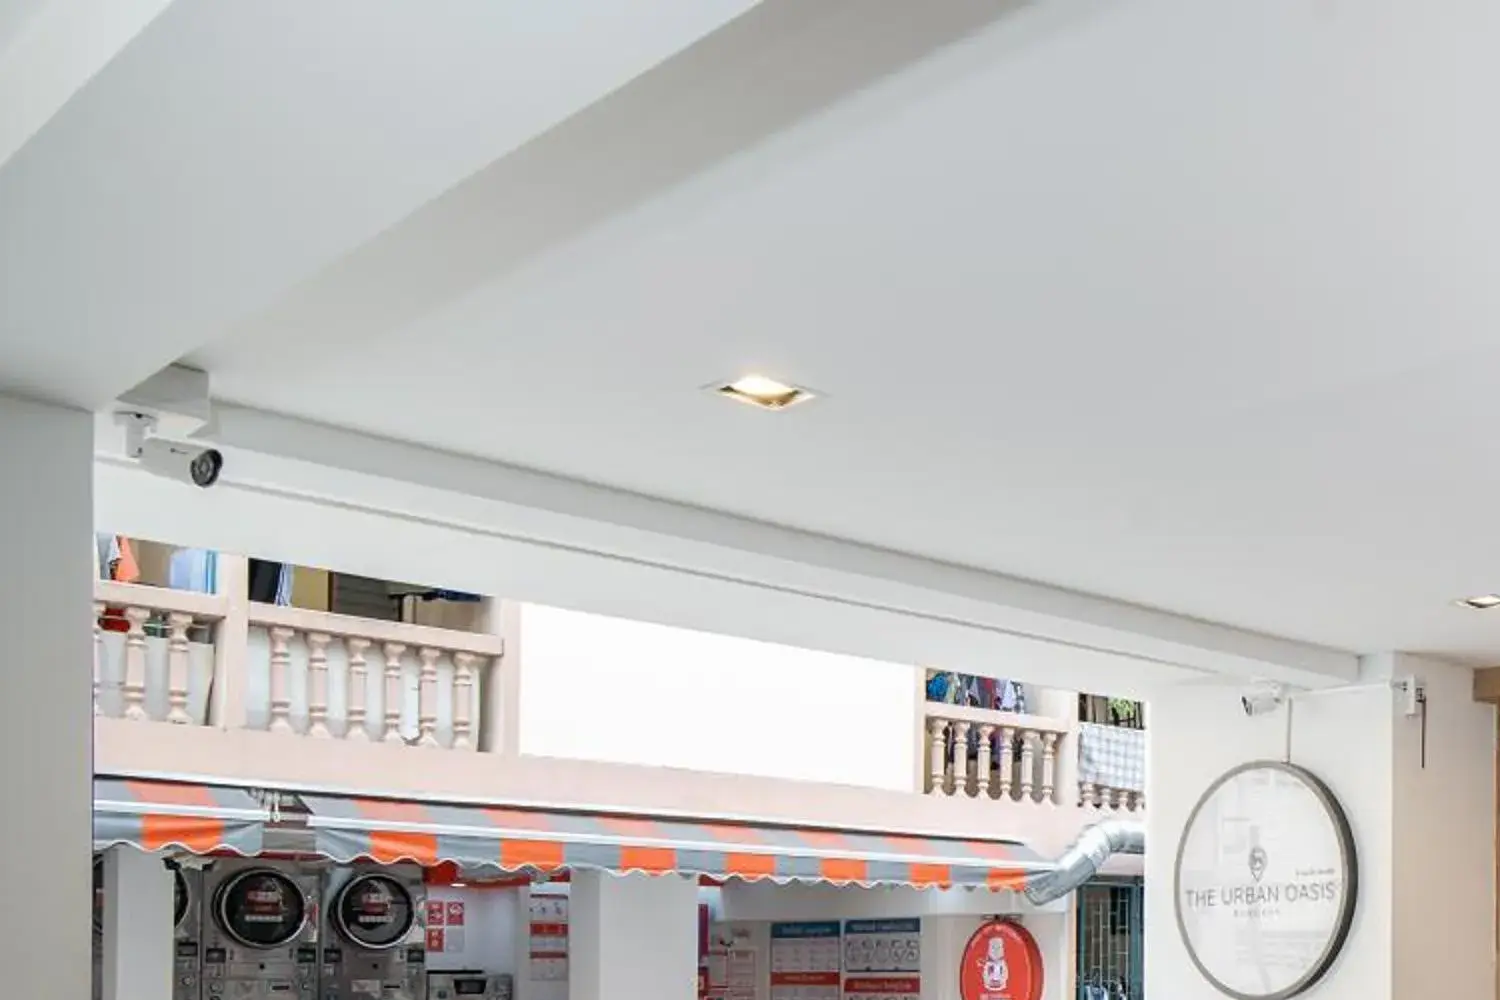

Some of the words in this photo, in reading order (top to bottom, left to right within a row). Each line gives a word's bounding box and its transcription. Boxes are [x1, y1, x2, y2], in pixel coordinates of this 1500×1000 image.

[1185, 889, 1217, 907] THE
[1221, 885, 1280, 905] URBAN
[1285, 881, 1337, 902] OASIS
